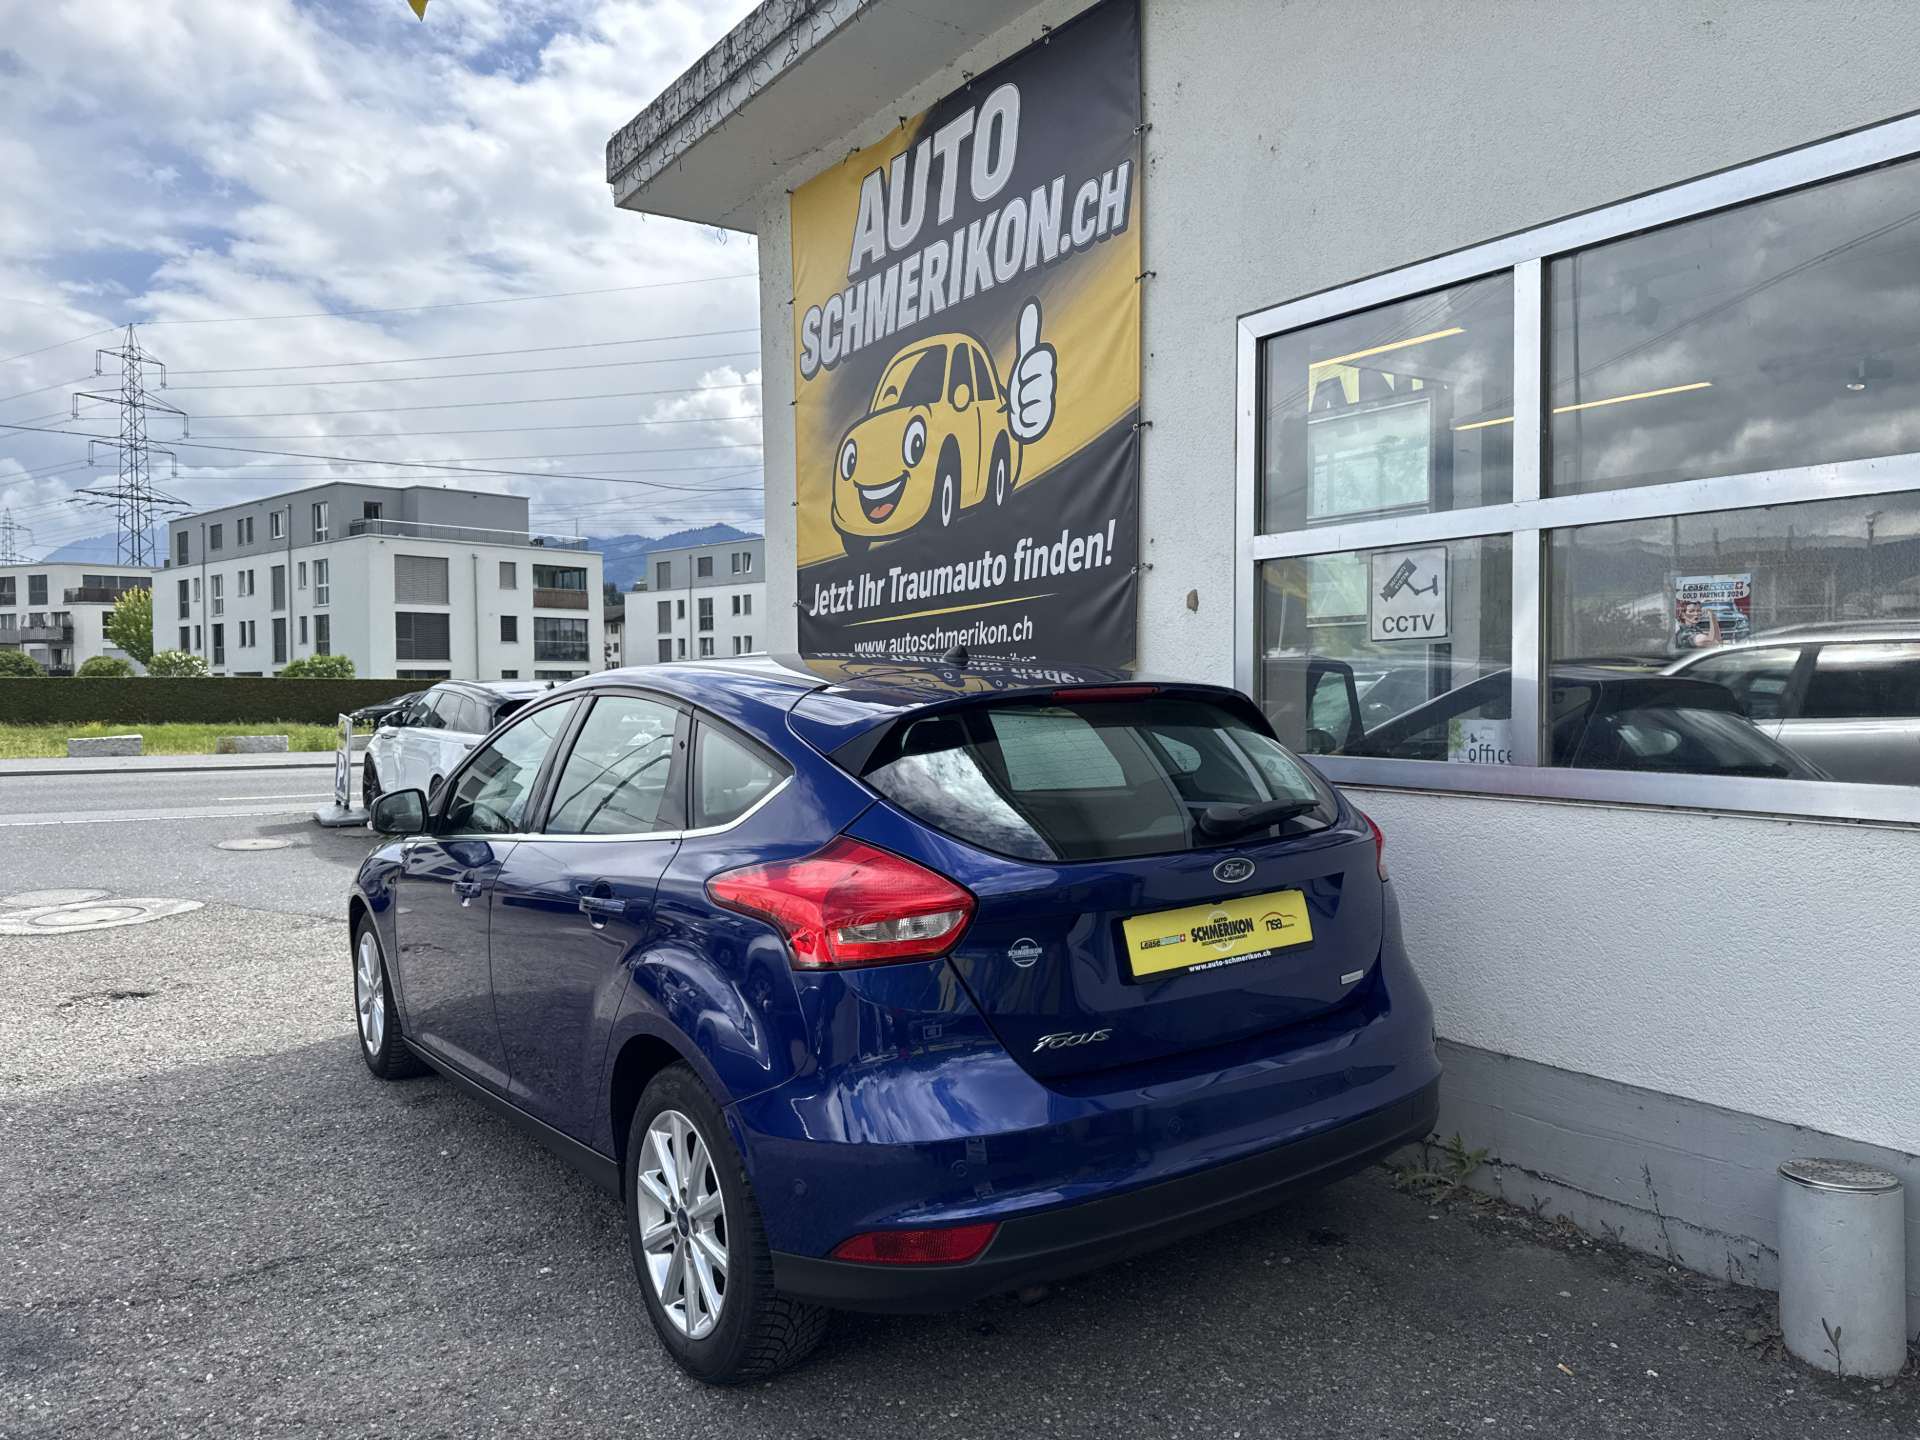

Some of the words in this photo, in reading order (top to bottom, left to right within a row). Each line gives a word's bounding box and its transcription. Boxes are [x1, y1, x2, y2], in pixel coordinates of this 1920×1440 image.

[848, 82, 1020, 277] AUTO
[800, 160, 1133, 380] SCHMERIKON.CH
[809, 583, 853, 617] Jetzt
[858, 573, 886, 609] Ihr
[888, 550, 1007, 606] Traumauto
[1013, 519, 1116, 582] finden!
[854, 616, 1033, 654] www.autoschmerikon.ch
[1382, 614, 1435, 634] CCTV
[1468, 743, 1512, 764] office
[1223, 862, 1246, 878] Ford
[1190, 918, 1254, 943] SCHMERIKON
[1188, 950, 1272, 973] www.auto-schmerikon.ch
